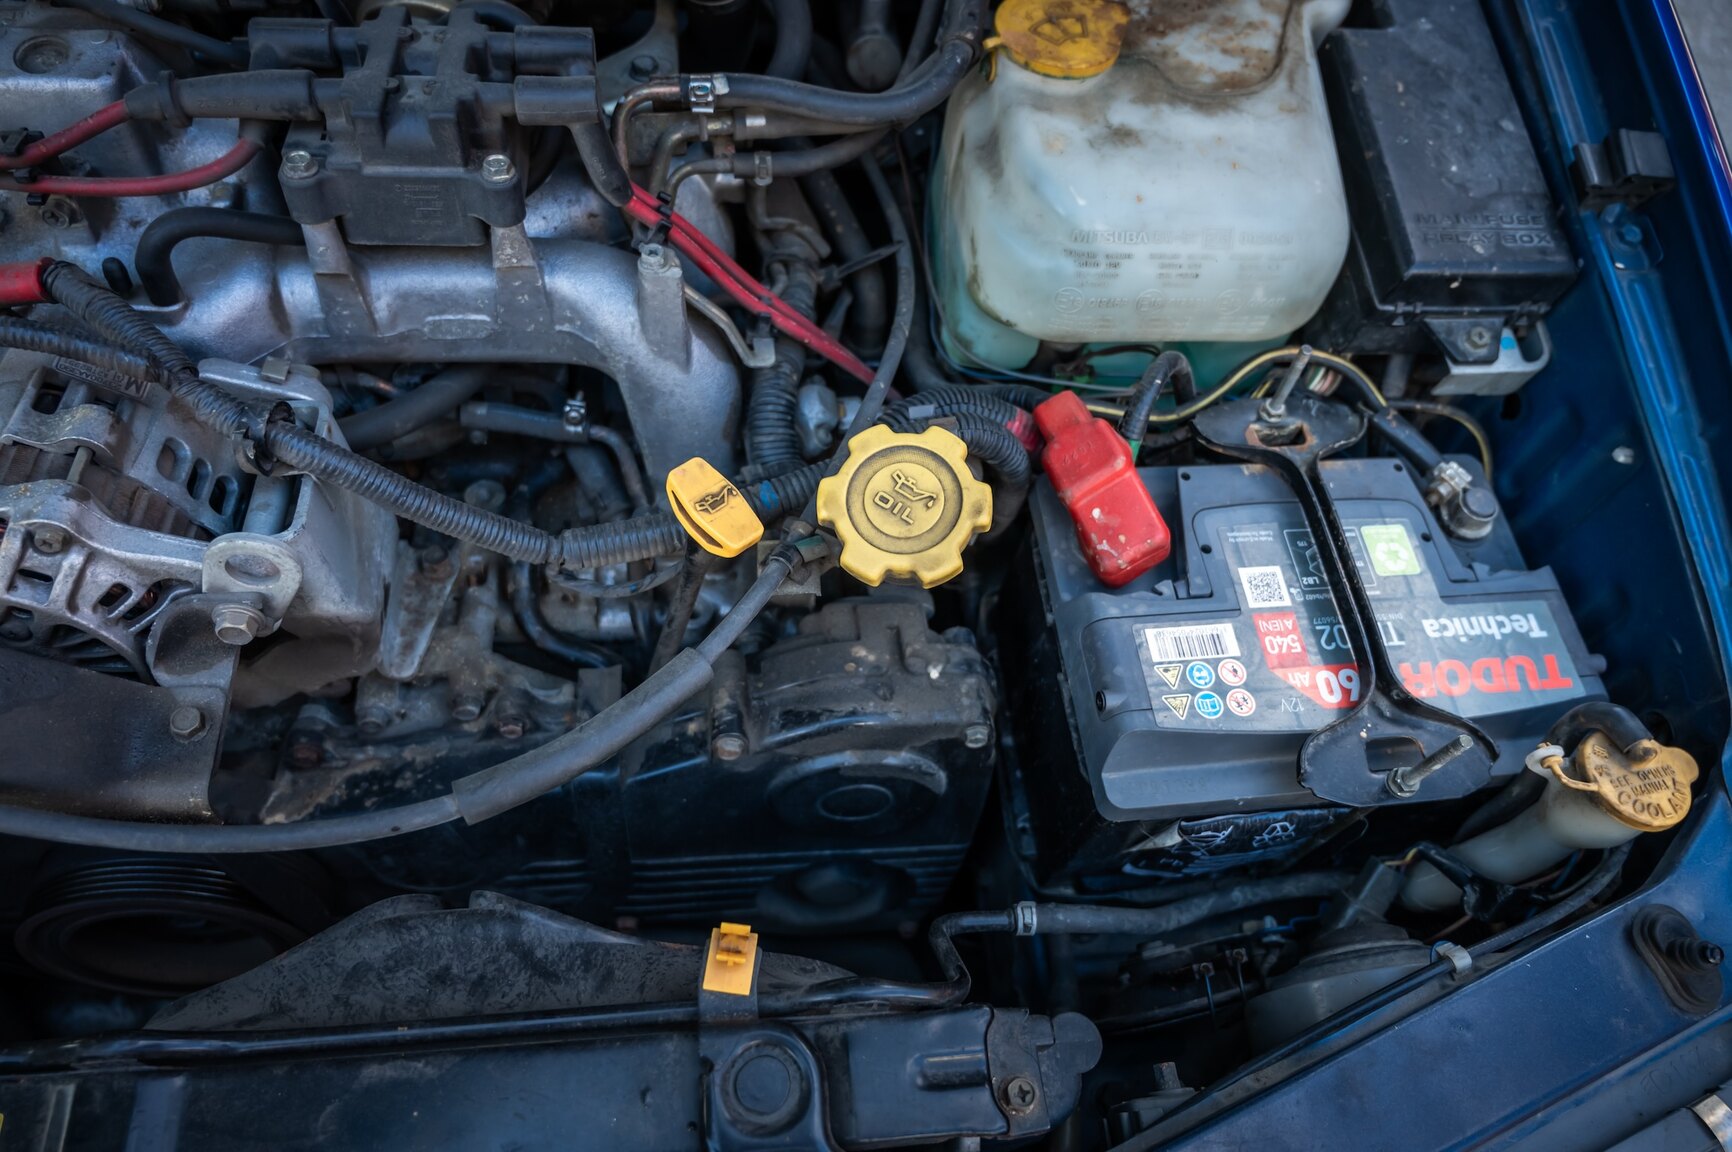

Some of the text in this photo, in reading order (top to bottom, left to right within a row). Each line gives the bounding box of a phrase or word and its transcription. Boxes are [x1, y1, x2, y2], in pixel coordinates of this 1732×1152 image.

[1417, 213, 1544, 226] MAIN FUSE
[1072, 231, 1149, 245] MITSUBA
[1423, 232, 1552, 245] RELAY BOX
[873, 491, 914, 525] OIL
[1302, 576, 1320, 584] LB2
[1421, 613, 1549, 642] Technica
[1264, 634, 1302, 654] 540
[1287, 668, 1360, 703] 60 Ah
[1399, 654, 1573, 698] TUDOR
[1281, 697, 1304, 712] 12V
[1618, 777, 1688, 819] COOLANT
